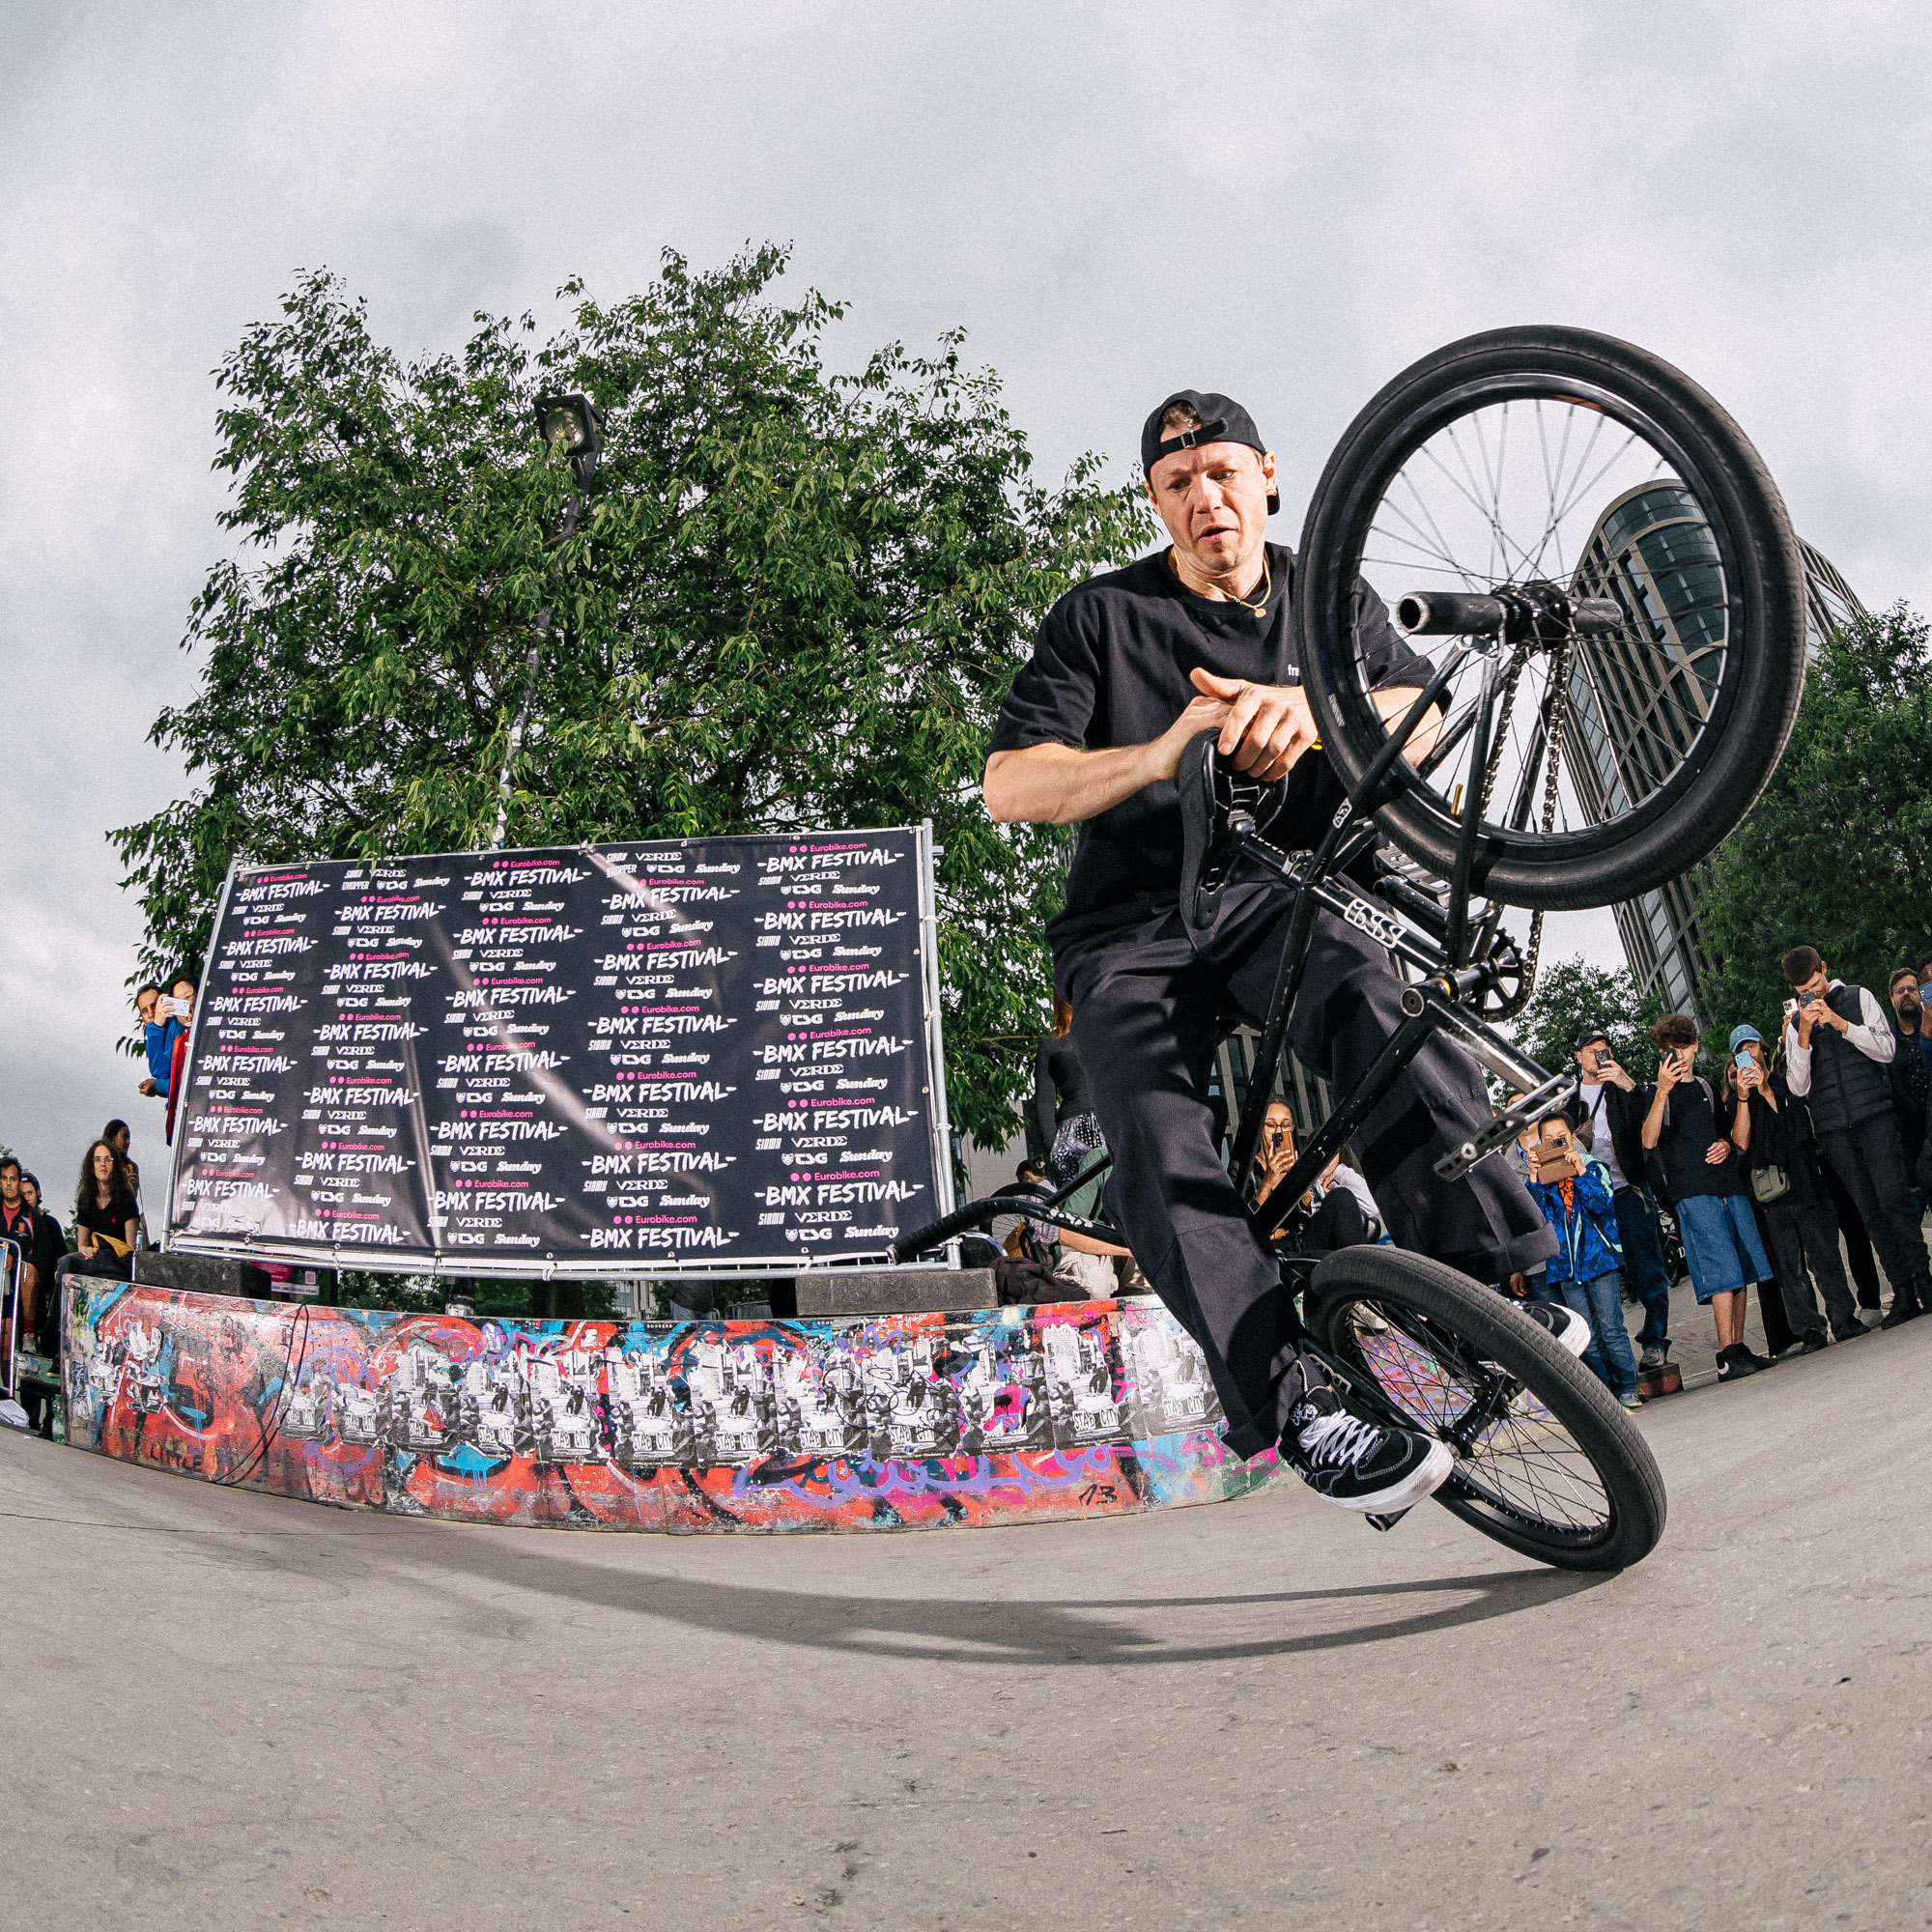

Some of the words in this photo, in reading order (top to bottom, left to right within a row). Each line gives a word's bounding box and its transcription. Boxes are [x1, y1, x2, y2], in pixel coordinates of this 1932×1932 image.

[810, 842, 867, 852] Eurobike.com
[635, 851, 682, 862] VERDE
[694, 863, 741, 874] Sunday
[790, 870, 840, 882] VERDE
[832, 884, 880, 895] Sunday
[377, 895, 420, 903] Eurobike.com
[809, 900, 868, 909] Eurobike.com
[522, 900, 565, 912] Sunday
[632, 909, 677, 923] VERDE
[668, 918, 714, 934] Sunday
[646, 939, 701, 951] Eurobike.com
[789, 933, 841, 945] VERDE
[365, 952, 410, 960] Eurobike.com
[832, 945, 882, 957] Sunday
[809, 963, 869, 972] Eurobike.com
[491, 977, 544, 985] Eurobike.com
[626, 975, 675, 985] VERDE
[665, 986, 713, 1000] Sunday
[641, 1005, 700, 1013] Eurobike.com
[788, 998, 842, 1009] VERDE
[834, 1008, 885, 1022] Sunday
[505, 1023, 550, 1036] Sunday
[810, 1028, 872, 1039] Eurobike.com
[485, 1041, 536, 1051] Eurobike.com
[620, 1039, 671, 1050] VERDE
[661, 1052, 710, 1065] Sunday
[637, 1070, 697, 1080] Eurobike.com
[789, 1064, 844, 1077] VERDE
[346, 1076, 392, 1085] Eurobike.com
[835, 1077, 889, 1090] Sunday
[810, 1097, 875, 1107] Eurobike.com
[479, 1109, 533, 1119] Eurobike.com
[616, 1108, 669, 1118] VERDE
[659, 1122, 710, 1135] Sunday
[338, 1142, 385, 1151] Eurobike.com
[635, 1140, 696, 1150] Eurobike.com
[791, 1135, 848, 1148] VERDE
[838, 1149, 894, 1163] Sunday
[496, 1160, 542, 1175] Sunday
[814, 1170, 880, 1181] Eurobike.com
[474, 1179, 529, 1188] Eurobike.com
[615, 1179, 668, 1191] VERDE
[659, 1194, 710, 1208] Sunday
[332, 1209, 380, 1220] Eurobike.com
[635, 1214, 697, 1224] Eurobike.com
[794, 1209, 853, 1223] VERDE
[843, 1223, 899, 1239] Sunday
[1163, 1400, 1184, 1418] STAB
[1187, 1395, 1205, 1414] CITY
[1073, 1410, 1095, 1431] STAB
[1099, 1407, 1119, 1427] CITY
[552, 1431, 570, 1448] STAB
[575, 1429, 590, 1448] CITY
[632, 1431, 652, 1450] STAB
[656, 1430, 673, 1450] CITY
[715, 1431, 735, 1450] STAB
[740, 1431, 757, 1449] CITY
[799, 1427, 821, 1448] STAB
[826, 1426, 844, 1446] CITY
[889, 1425, 911, 1444] STAB
